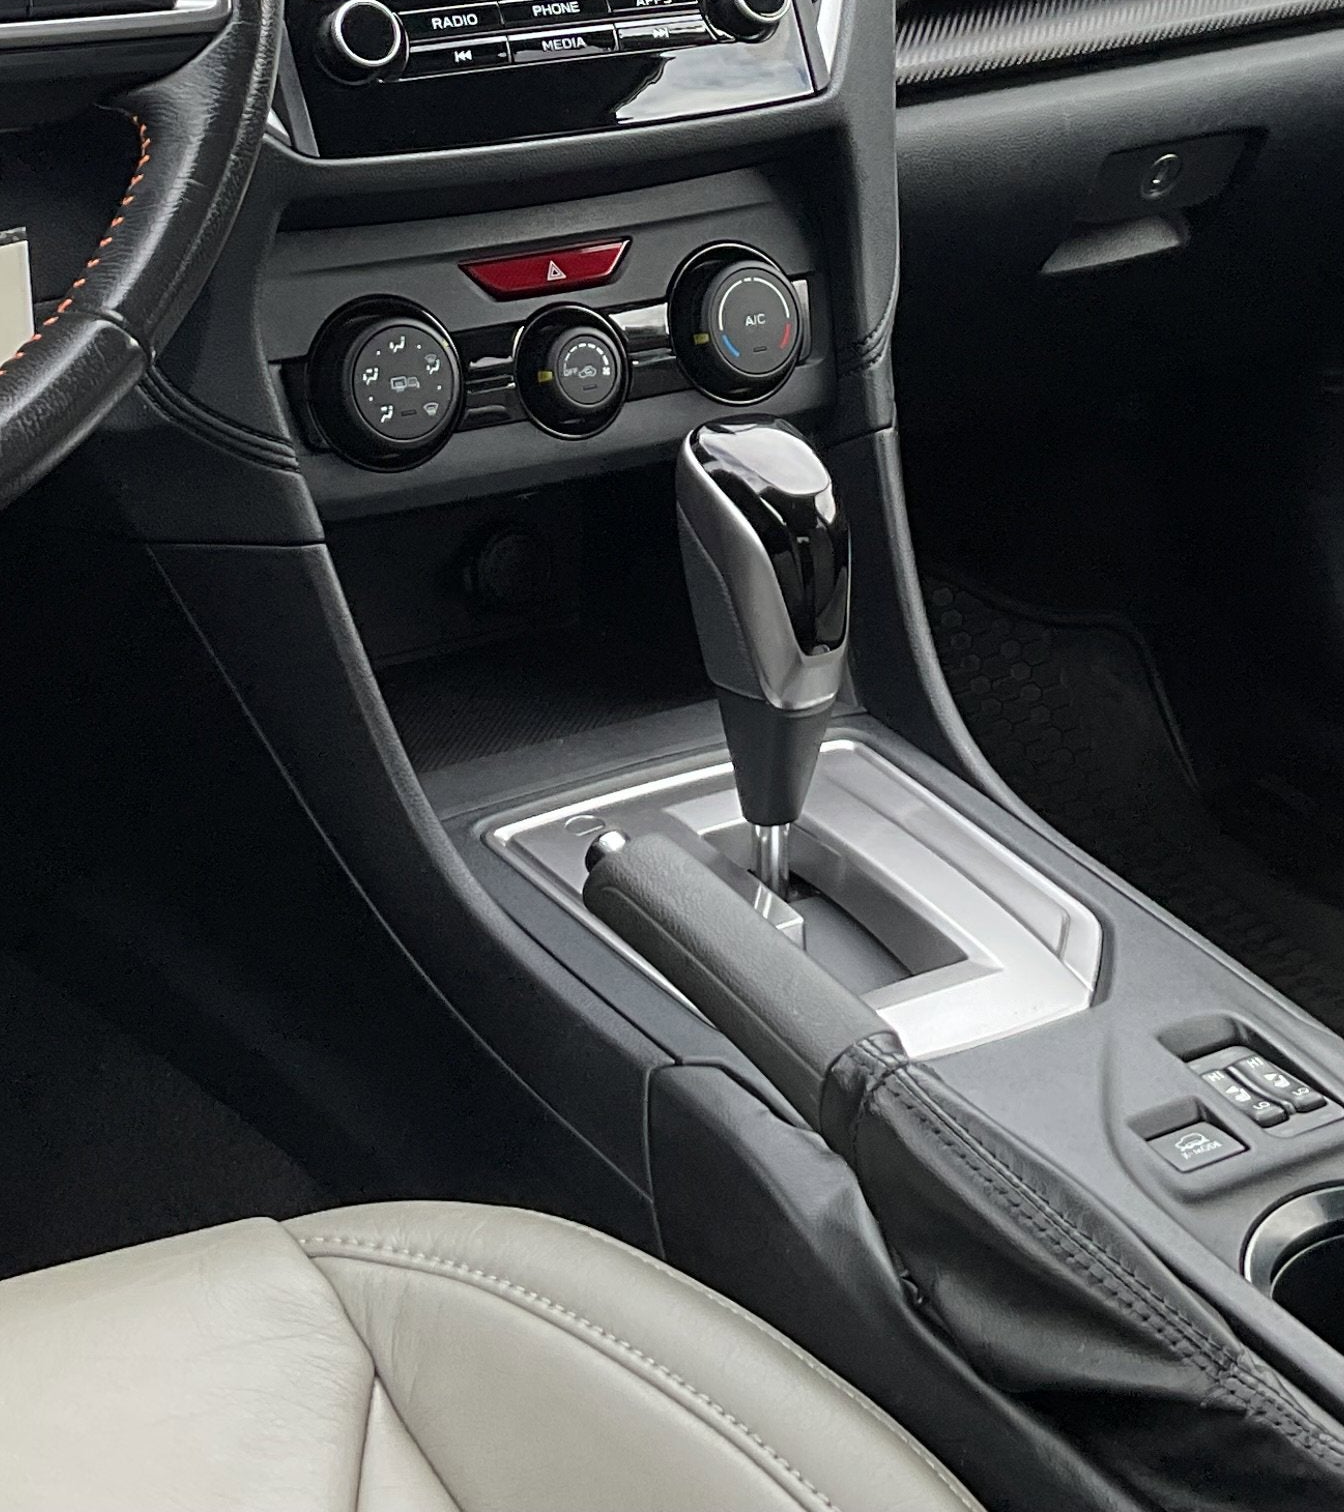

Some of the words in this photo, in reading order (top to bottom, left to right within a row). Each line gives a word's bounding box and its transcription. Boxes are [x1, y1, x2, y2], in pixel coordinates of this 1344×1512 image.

[532, 0, 580, 16] PHONE
[431, 13, 479, 31] RADIO
[541, 35, 587, 52] MEDIA
[745, 313, 766, 328] A/C
[1246, 1056, 1264, 1069] HI
[1207, 1070, 1224, 1083] HI
